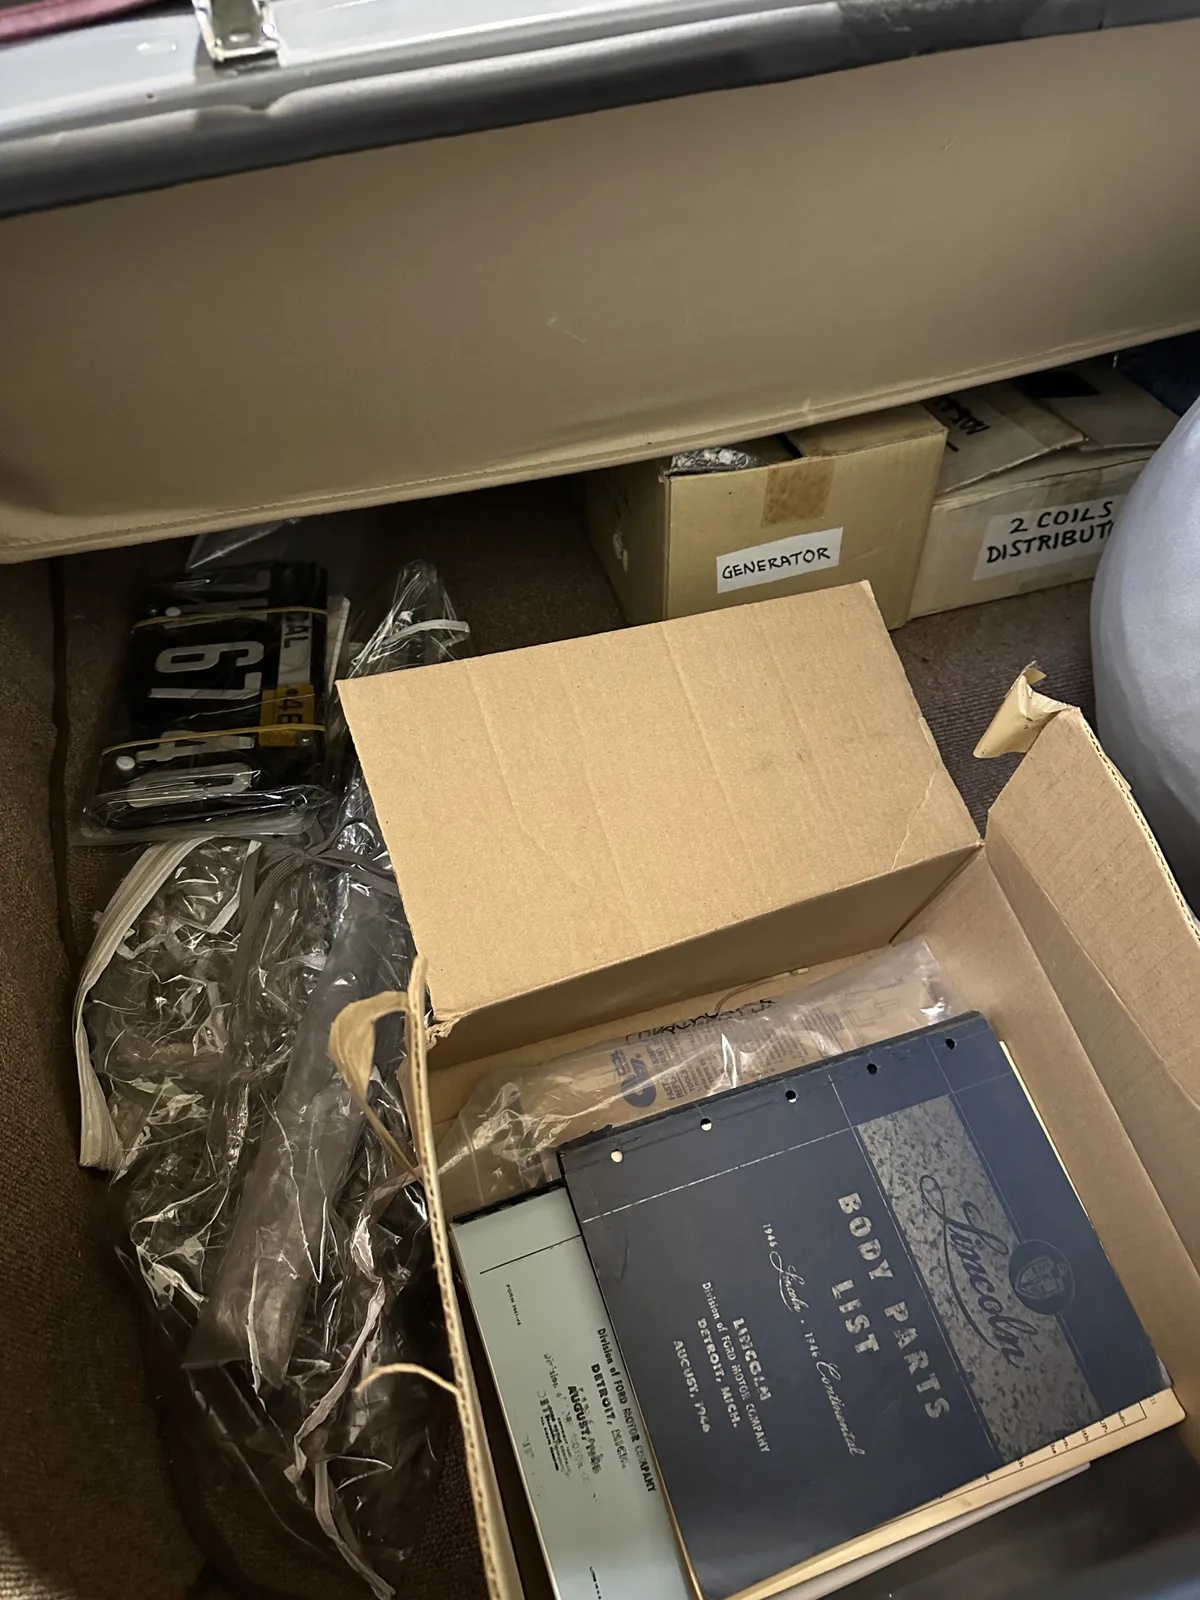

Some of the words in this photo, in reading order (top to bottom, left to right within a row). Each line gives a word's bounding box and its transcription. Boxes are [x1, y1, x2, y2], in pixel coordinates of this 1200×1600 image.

[1009, 518, 1027, 534] 2
[1037, 501, 1113, 528] COILS
[986, 520, 1115, 563] DISTRIBUT
[722, 547, 831, 579] GENERATOR
[762, 1223, 778, 1247] 1946
[769, 1250, 810, 1313] Lincoln
[919, 1174, 1041, 1370] Lincoln
[702, 1281, 721, 1320] Division
[831, 1279, 880, 1354] LIST
[838, 1192, 894, 1280] BODY
[884, 1302, 950, 1419] PARTS
[597, 1327, 613, 1365] Division
[717, 1321, 727, 1333] of
[804, 1332, 821, 1358] 1946
[673, 1339, 700, 1398] AUGUST,
[721, 1335, 736, 1361] FORD
[609, 1366, 621, 1377] of
[614, 1379, 628, 1404] FORD
[697, 1317, 725, 1383] DETROIT,
[720, 1386, 742, 1429] MICH.
[731, 1364, 750, 1401] MOTOR
[568, 1385, 592, 1441] AUGUST,
[590, 1363, 616, 1426] DETROIT,
[816, 1360, 866, 1456] Continental
[622, 1408, 640, 1443] MOTOR
[745, 1403, 770, 1453] COMPANY
[637, 1444, 657, 1492] COMPANY
